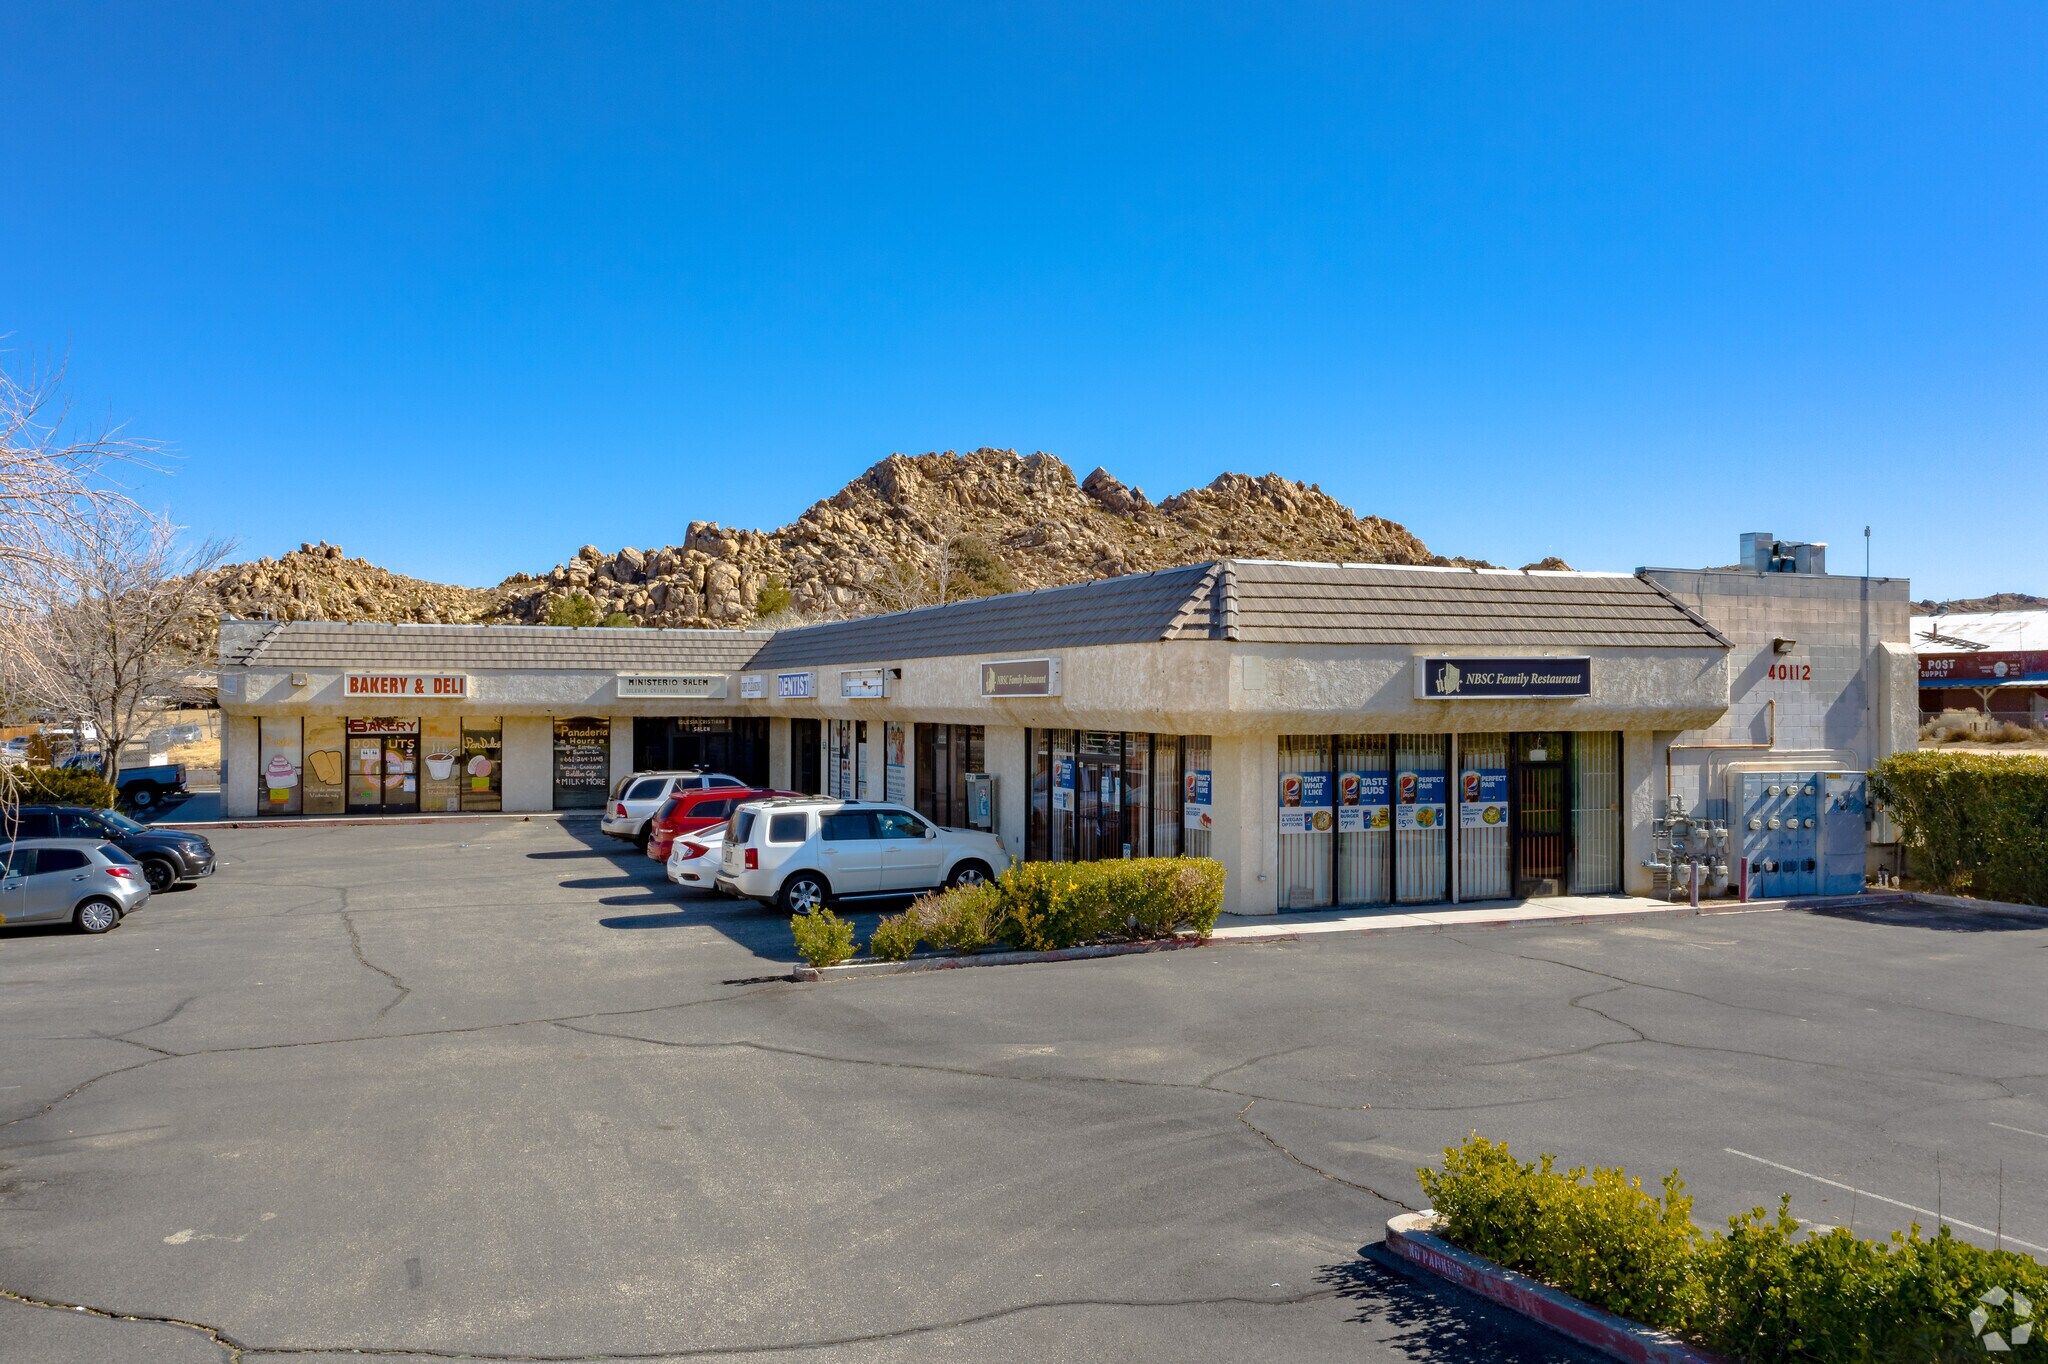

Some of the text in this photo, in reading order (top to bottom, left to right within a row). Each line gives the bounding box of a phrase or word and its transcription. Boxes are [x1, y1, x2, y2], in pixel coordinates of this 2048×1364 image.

[1928, 659, 1956, 670] POST
[1768, 664, 1811, 680] 40112
[350, 677, 464, 694] BAKERY & DELI
[779, 676, 808, 695] DENTIST
[1009, 674, 1023, 687] Family
[1023, 674, 1047, 684] Restaurant
[1466, 673, 1581, 687] NBSC Family Restaurant
[348, 719, 417, 732] BAKERY
[561, 778, 581, 786] MILK
[586, 778, 606, 786] MORE
[1361, 777, 1388, 786] TASTE
[1361, 786, 1385, 795] BUDS
[1408, 1243, 1464, 1281] NO PARKING
